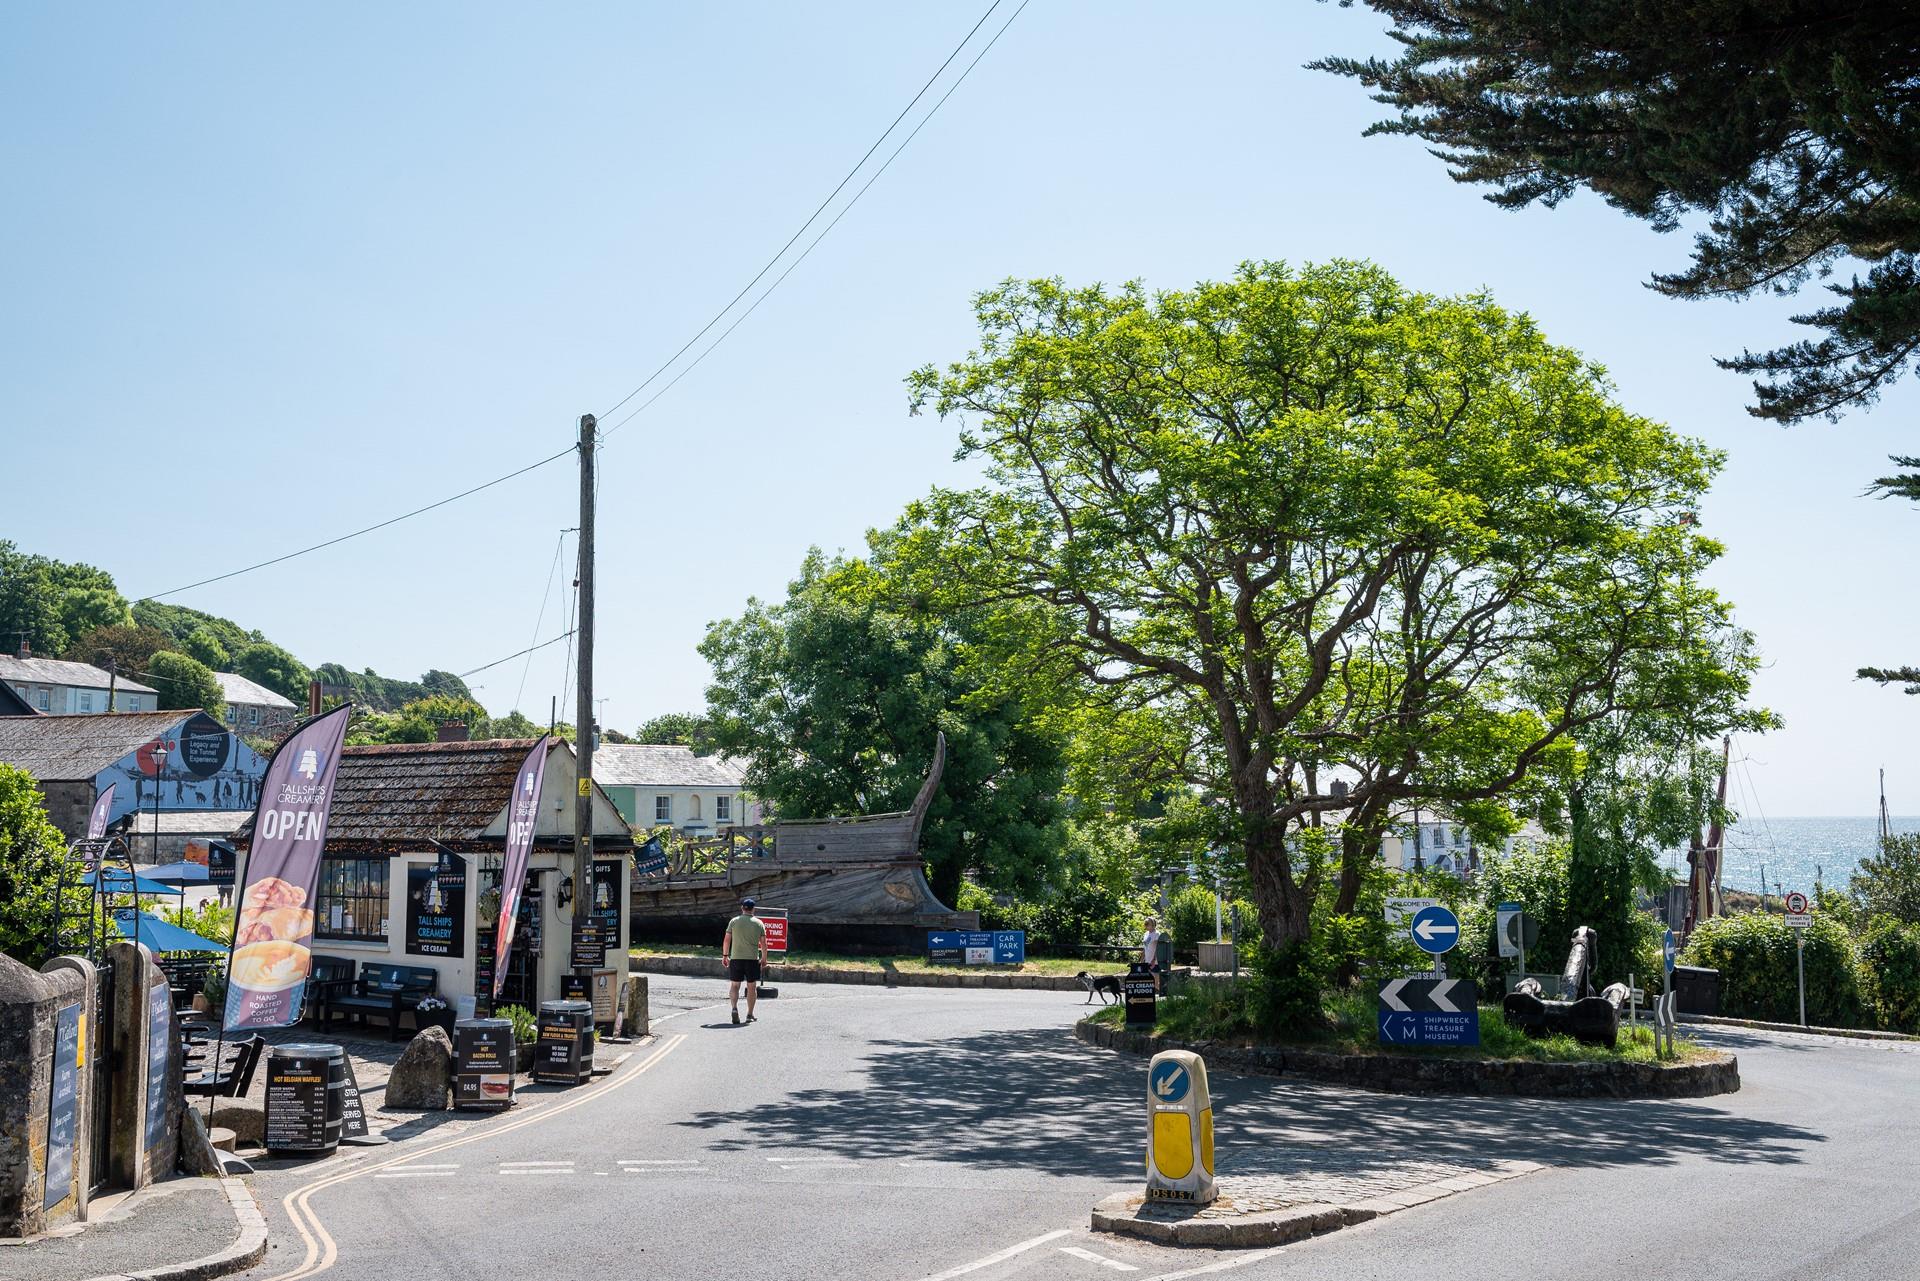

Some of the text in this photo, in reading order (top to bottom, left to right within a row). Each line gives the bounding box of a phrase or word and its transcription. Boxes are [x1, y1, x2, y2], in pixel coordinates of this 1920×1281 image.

[190, 741, 209, 749] Legacy
[189, 756, 218, 764] Experience
[262, 809, 323, 841] OPEN
[595, 865, 611, 873] GIFTS
[601, 909, 618, 918] SHIPS
[418, 915, 452, 927] TALL SHIPS
[418, 927, 452, 938] CREAMERY
[421, 944, 448, 953] ICE CREAM
[249, 1000, 282, 1009] ROASTED
[251, 1007, 278, 1017] COFFEE
[1424, 1016, 1470, 1024] SHIPWRECK
[463, 1083, 477, 1091] £4.95
[342, 1110, 361, 1119] SERVED
[347, 1121, 361, 1130] HERE
[1152, 1188, 1193, 1200] DS057
